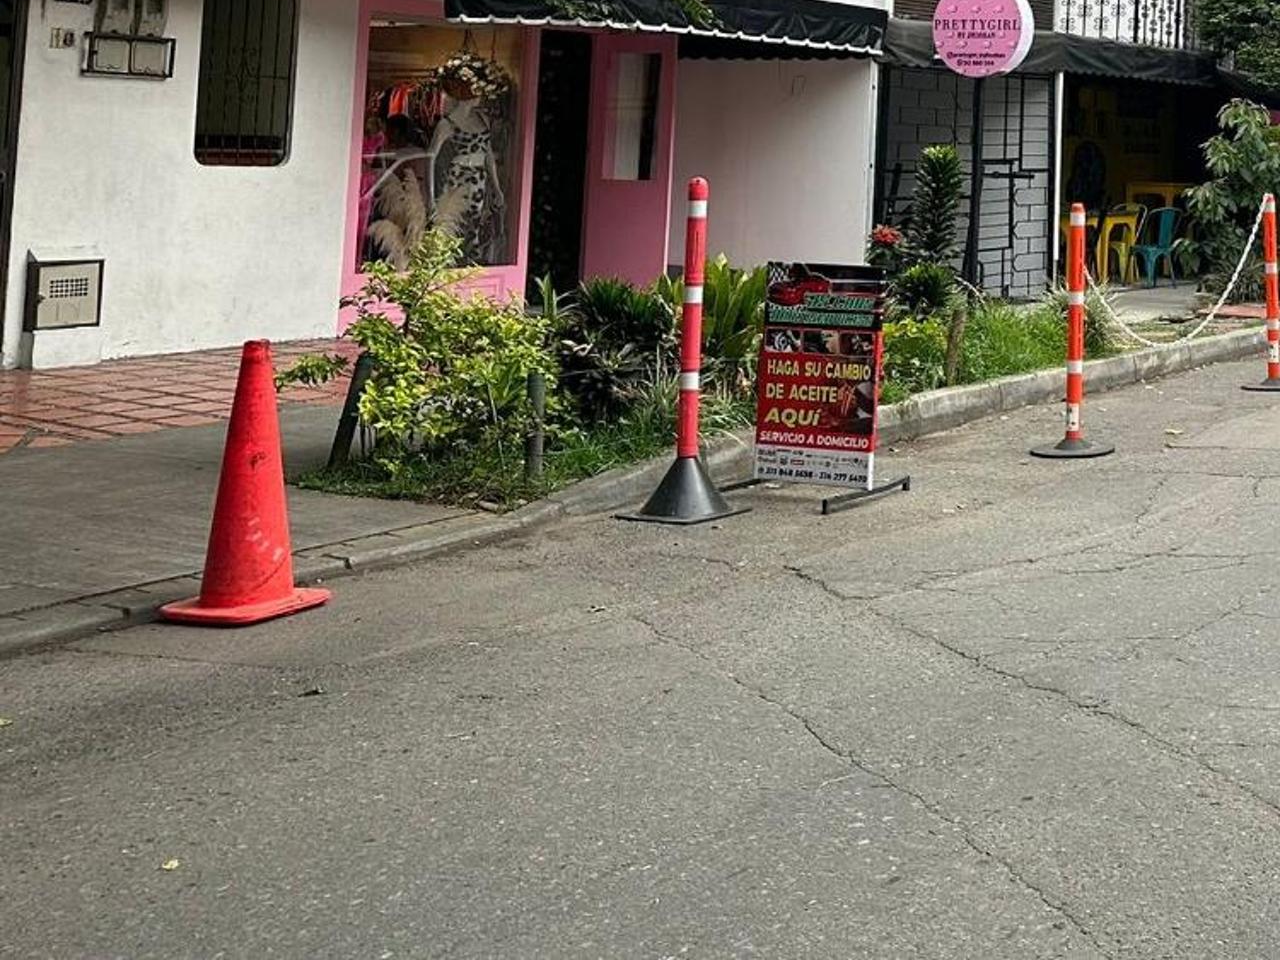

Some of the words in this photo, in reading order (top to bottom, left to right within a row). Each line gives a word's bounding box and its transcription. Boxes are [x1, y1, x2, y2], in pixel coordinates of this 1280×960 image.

[935, 19, 1020, 30] PRETTYGIRL
[767, 359, 799, 376] HAGA
[805, 361, 821, 377] SU
[825, 362, 871, 380] CAMBIO
[765, 383, 784, 399] DE
[789, 384, 837, 403] ACEITE
[759, 430, 805, 444] SERVICIO
[806, 434, 814, 444] A
[816, 435, 868, 449] DOMICILIO
